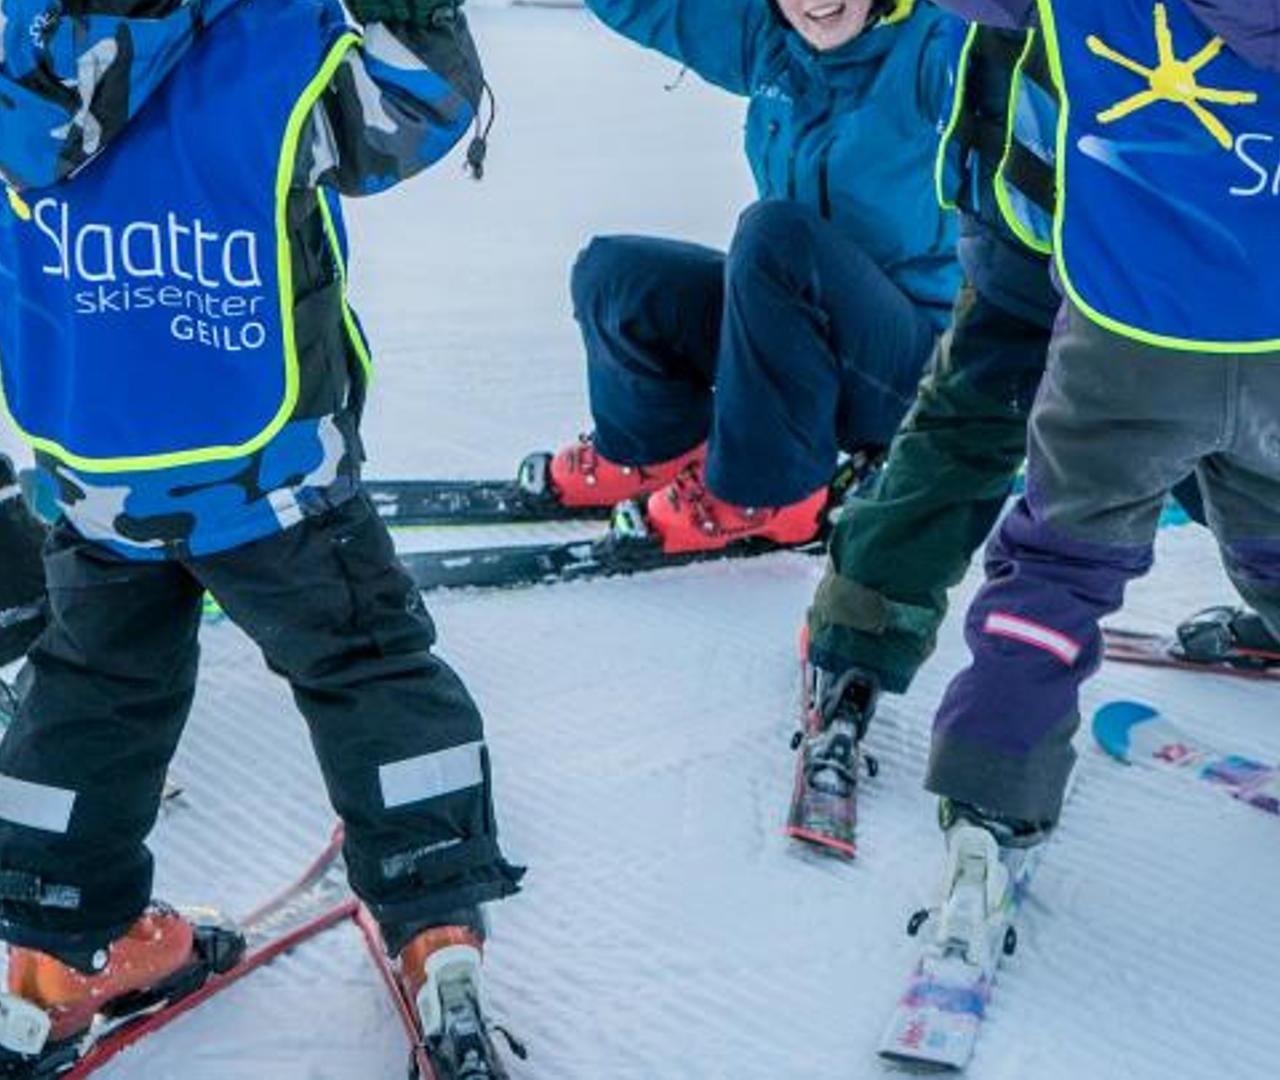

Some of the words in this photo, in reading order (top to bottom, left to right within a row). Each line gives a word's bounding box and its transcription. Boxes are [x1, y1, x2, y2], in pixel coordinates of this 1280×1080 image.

[34, 196, 262, 288] Slaatta
[75, 283, 265, 318] skisenter
[170, 314, 266, 351] GEILO
